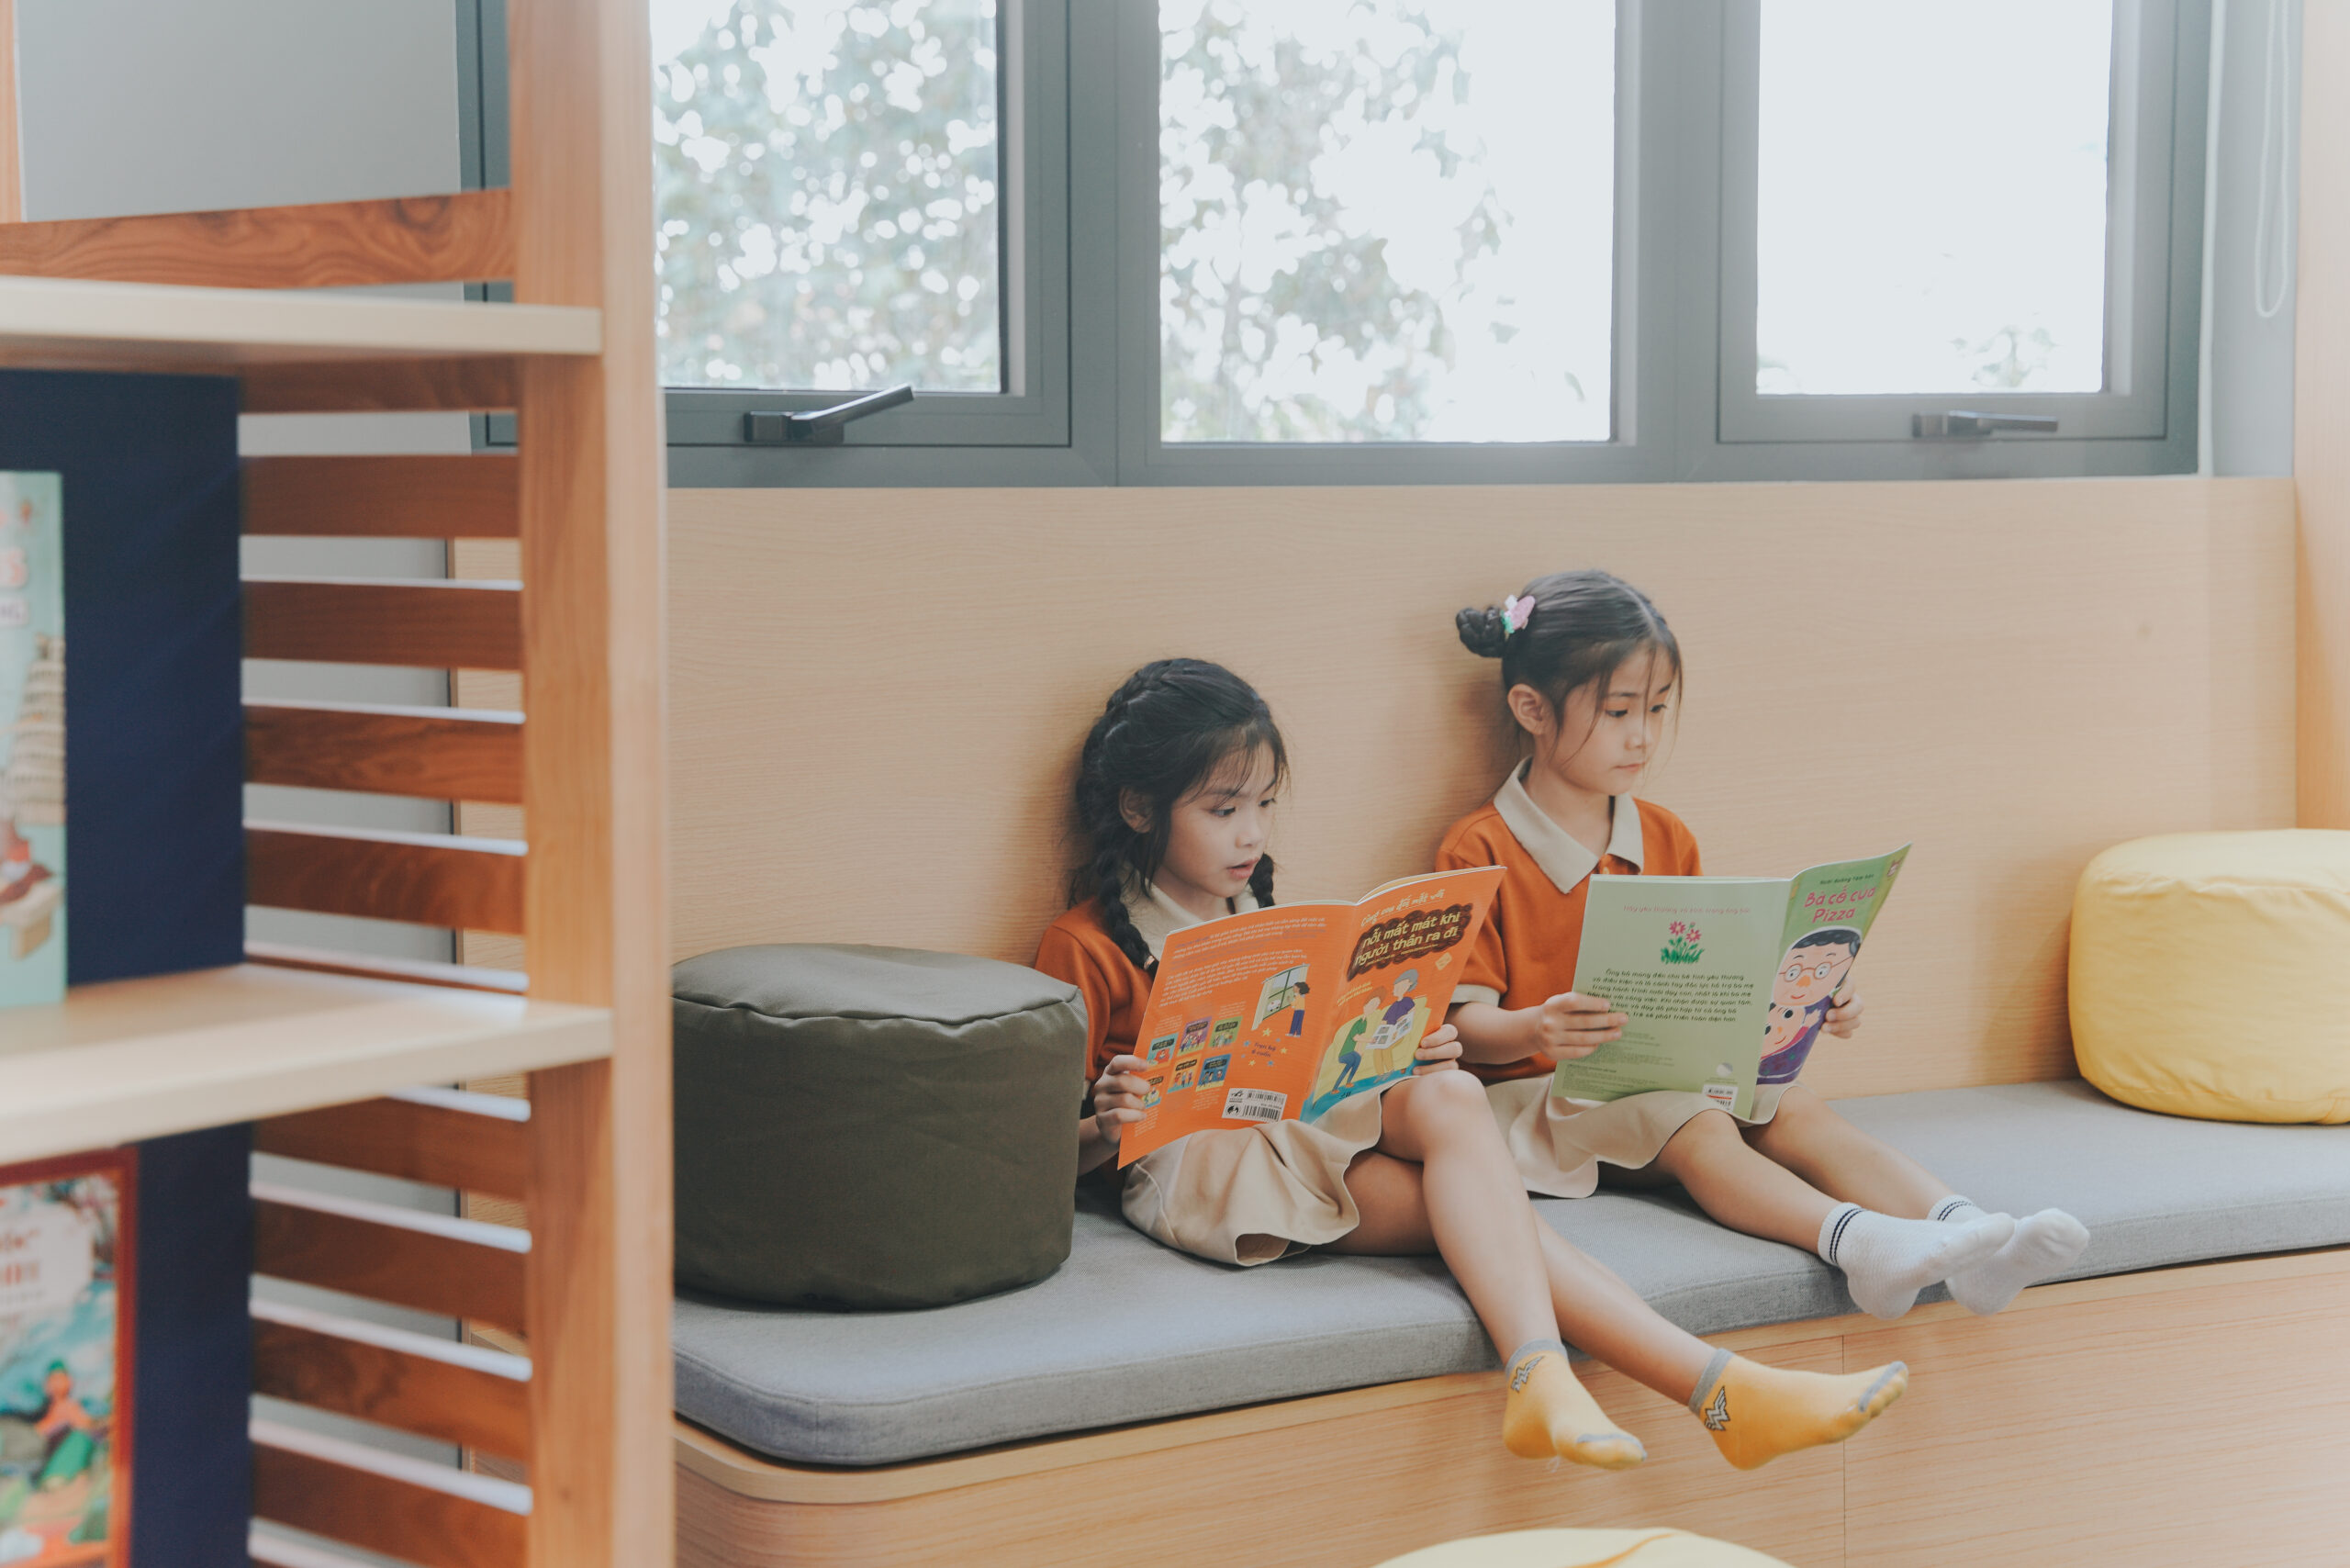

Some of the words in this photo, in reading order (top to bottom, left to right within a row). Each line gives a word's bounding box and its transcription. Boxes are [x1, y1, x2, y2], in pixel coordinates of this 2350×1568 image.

[1828, 885, 1848, 905] cố
[1850, 885, 1876, 902] của
[1362, 927, 1382, 948] nỗi
[1383, 920, 1410, 940] mất
[1411, 916, 1438, 933] mát
[1439, 912, 1461, 925] khi
[1812, 908, 1856, 924] Pizza
[1355, 942, 1390, 966] người
[1393, 935, 1423, 951] thân
[1425, 931, 1441, 943] ra
[1443, 926, 1460, 939] đi
